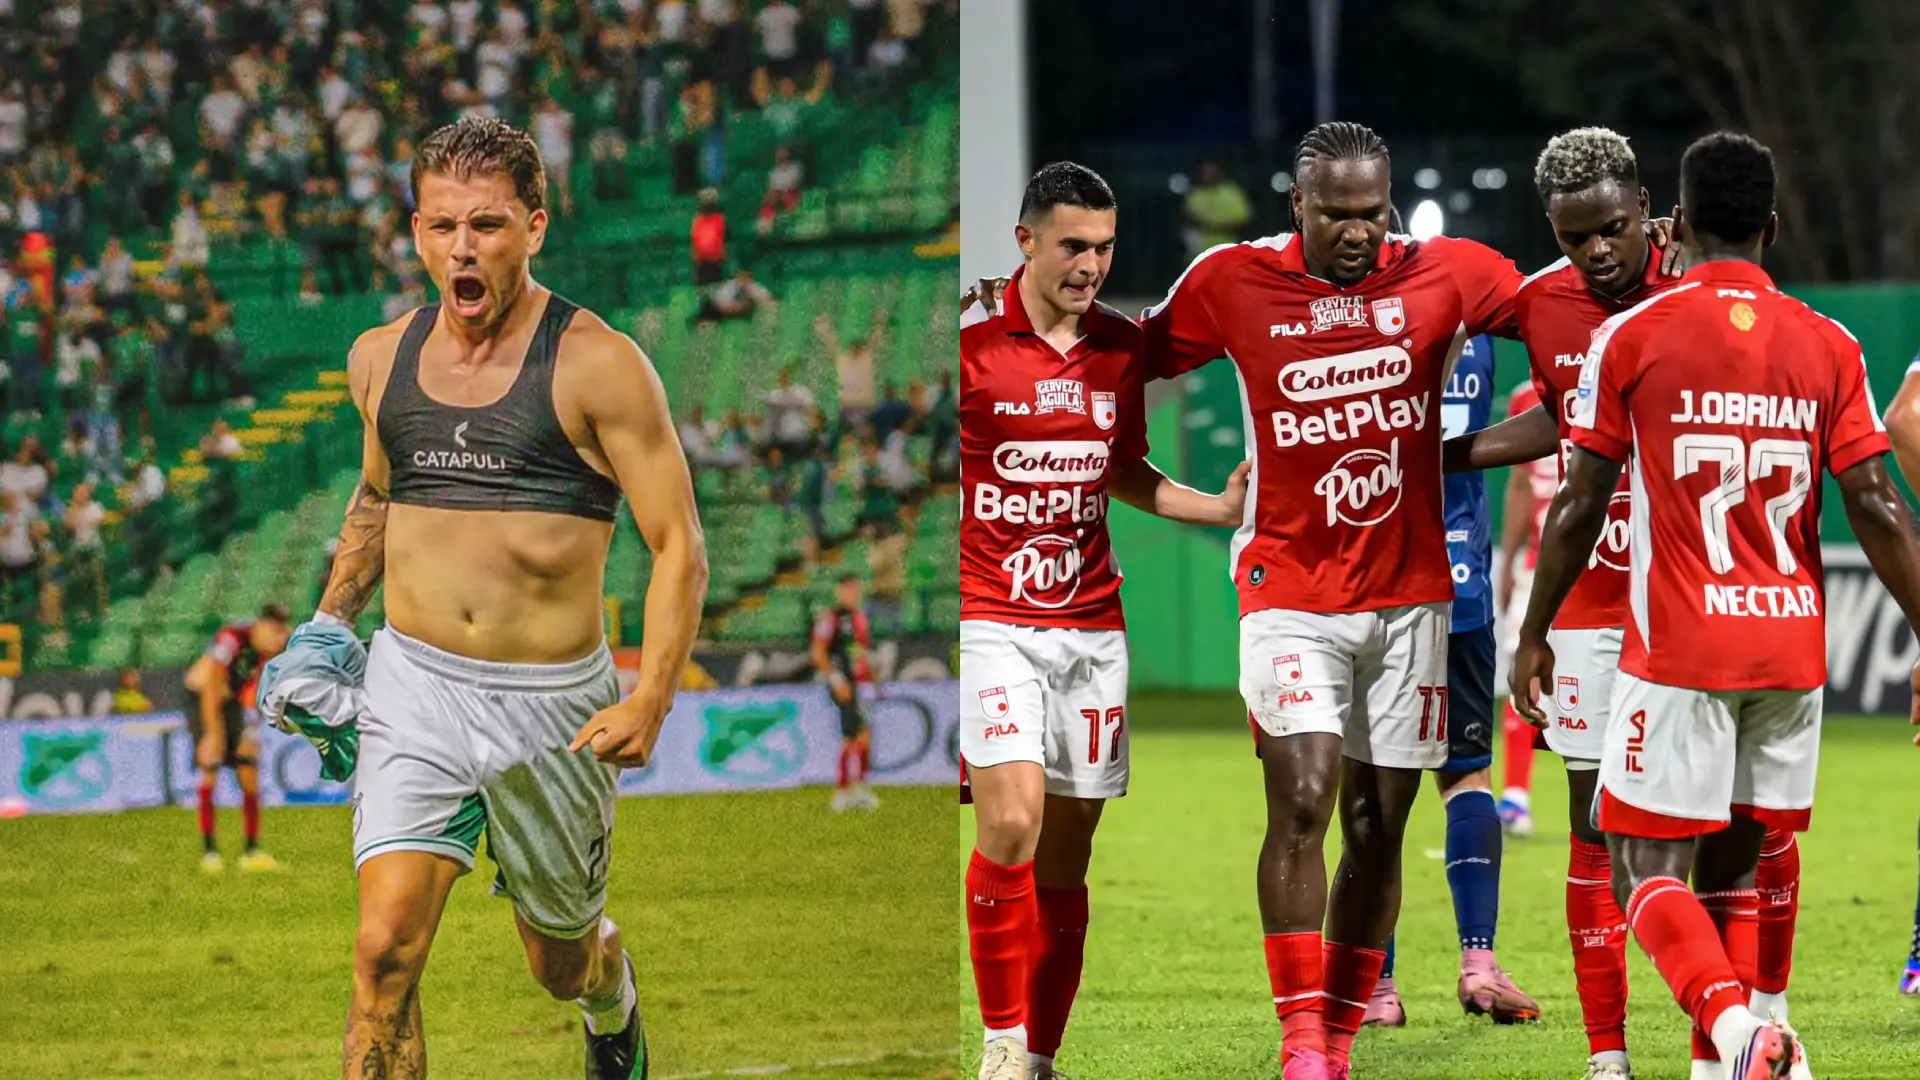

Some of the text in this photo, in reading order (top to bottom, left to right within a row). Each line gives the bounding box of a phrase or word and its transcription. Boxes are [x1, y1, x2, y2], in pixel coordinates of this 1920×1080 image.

[1270, 324, 1307, 338] FILA
[1316, 307, 1360, 327] AGUILA
[1555, 354, 1585, 367] FILA
[1282, 359, 1406, 392] Colanta
[994, 402, 1030, 415] FILA
[1040, 392, 1081, 408] AGUILA
[1670, 390, 1818, 432] J.OBRIAN
[1271, 391, 1429, 447] BetPlay
[997, 448, 1106, 472] Colanta
[1314, 437, 1403, 527] Pool
[1673, 434, 1811, 575] 77
[1001, 529, 1085, 601] Pool
[1704, 584, 1818, 617] NECTAR
[1278, 690, 1313, 708] FILA
[1418, 686, 1448, 741] 11
[1558, 716, 1588, 730] FILA
[985, 722, 1019, 739] FILA
[1080, 705, 1124, 764] 17
[1626, 709, 1646, 772] FILA
[1568, 927, 1611, 935] ANTA
